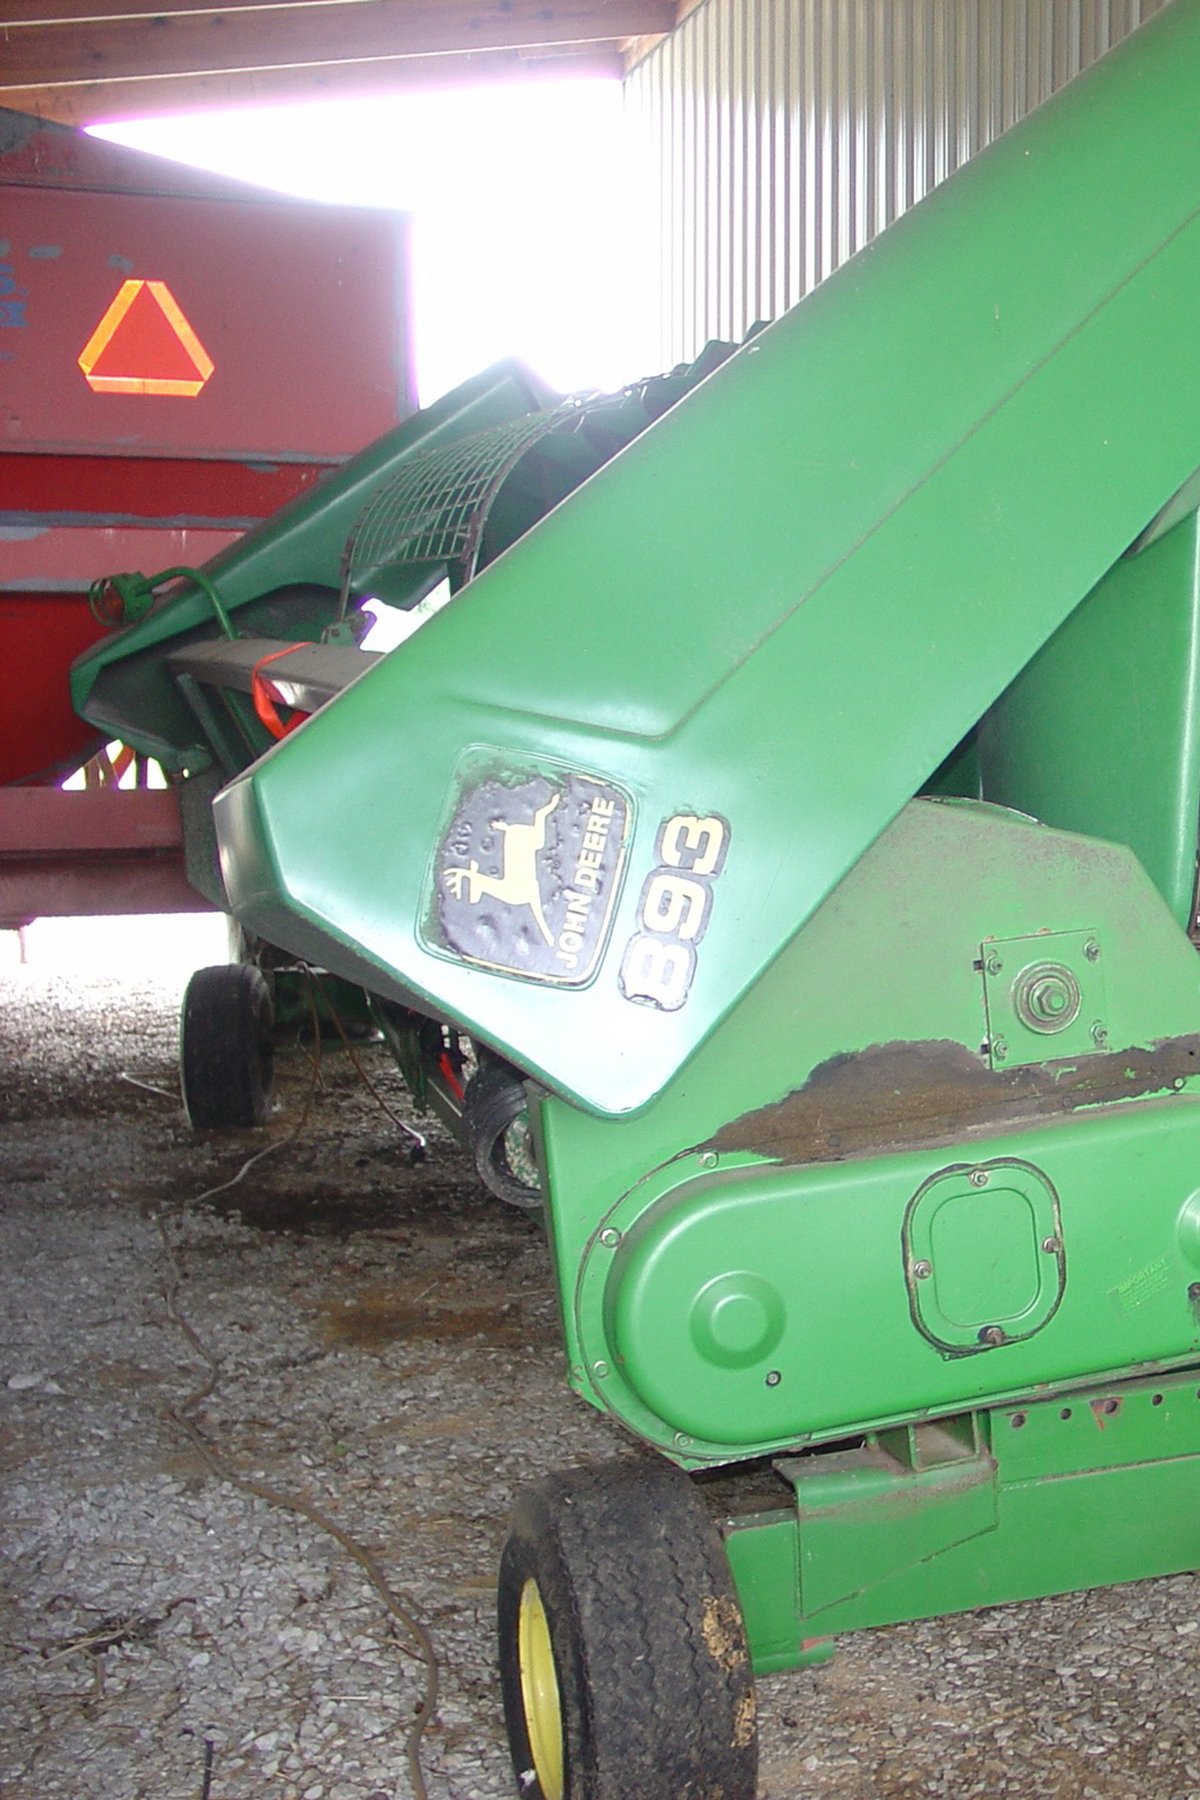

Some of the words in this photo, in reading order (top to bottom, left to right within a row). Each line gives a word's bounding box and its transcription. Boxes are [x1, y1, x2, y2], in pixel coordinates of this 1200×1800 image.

[555, 887, 593, 970] JOHN
[574, 797, 615, 896] DEERE
[621, 814, 727, 1010] 893
